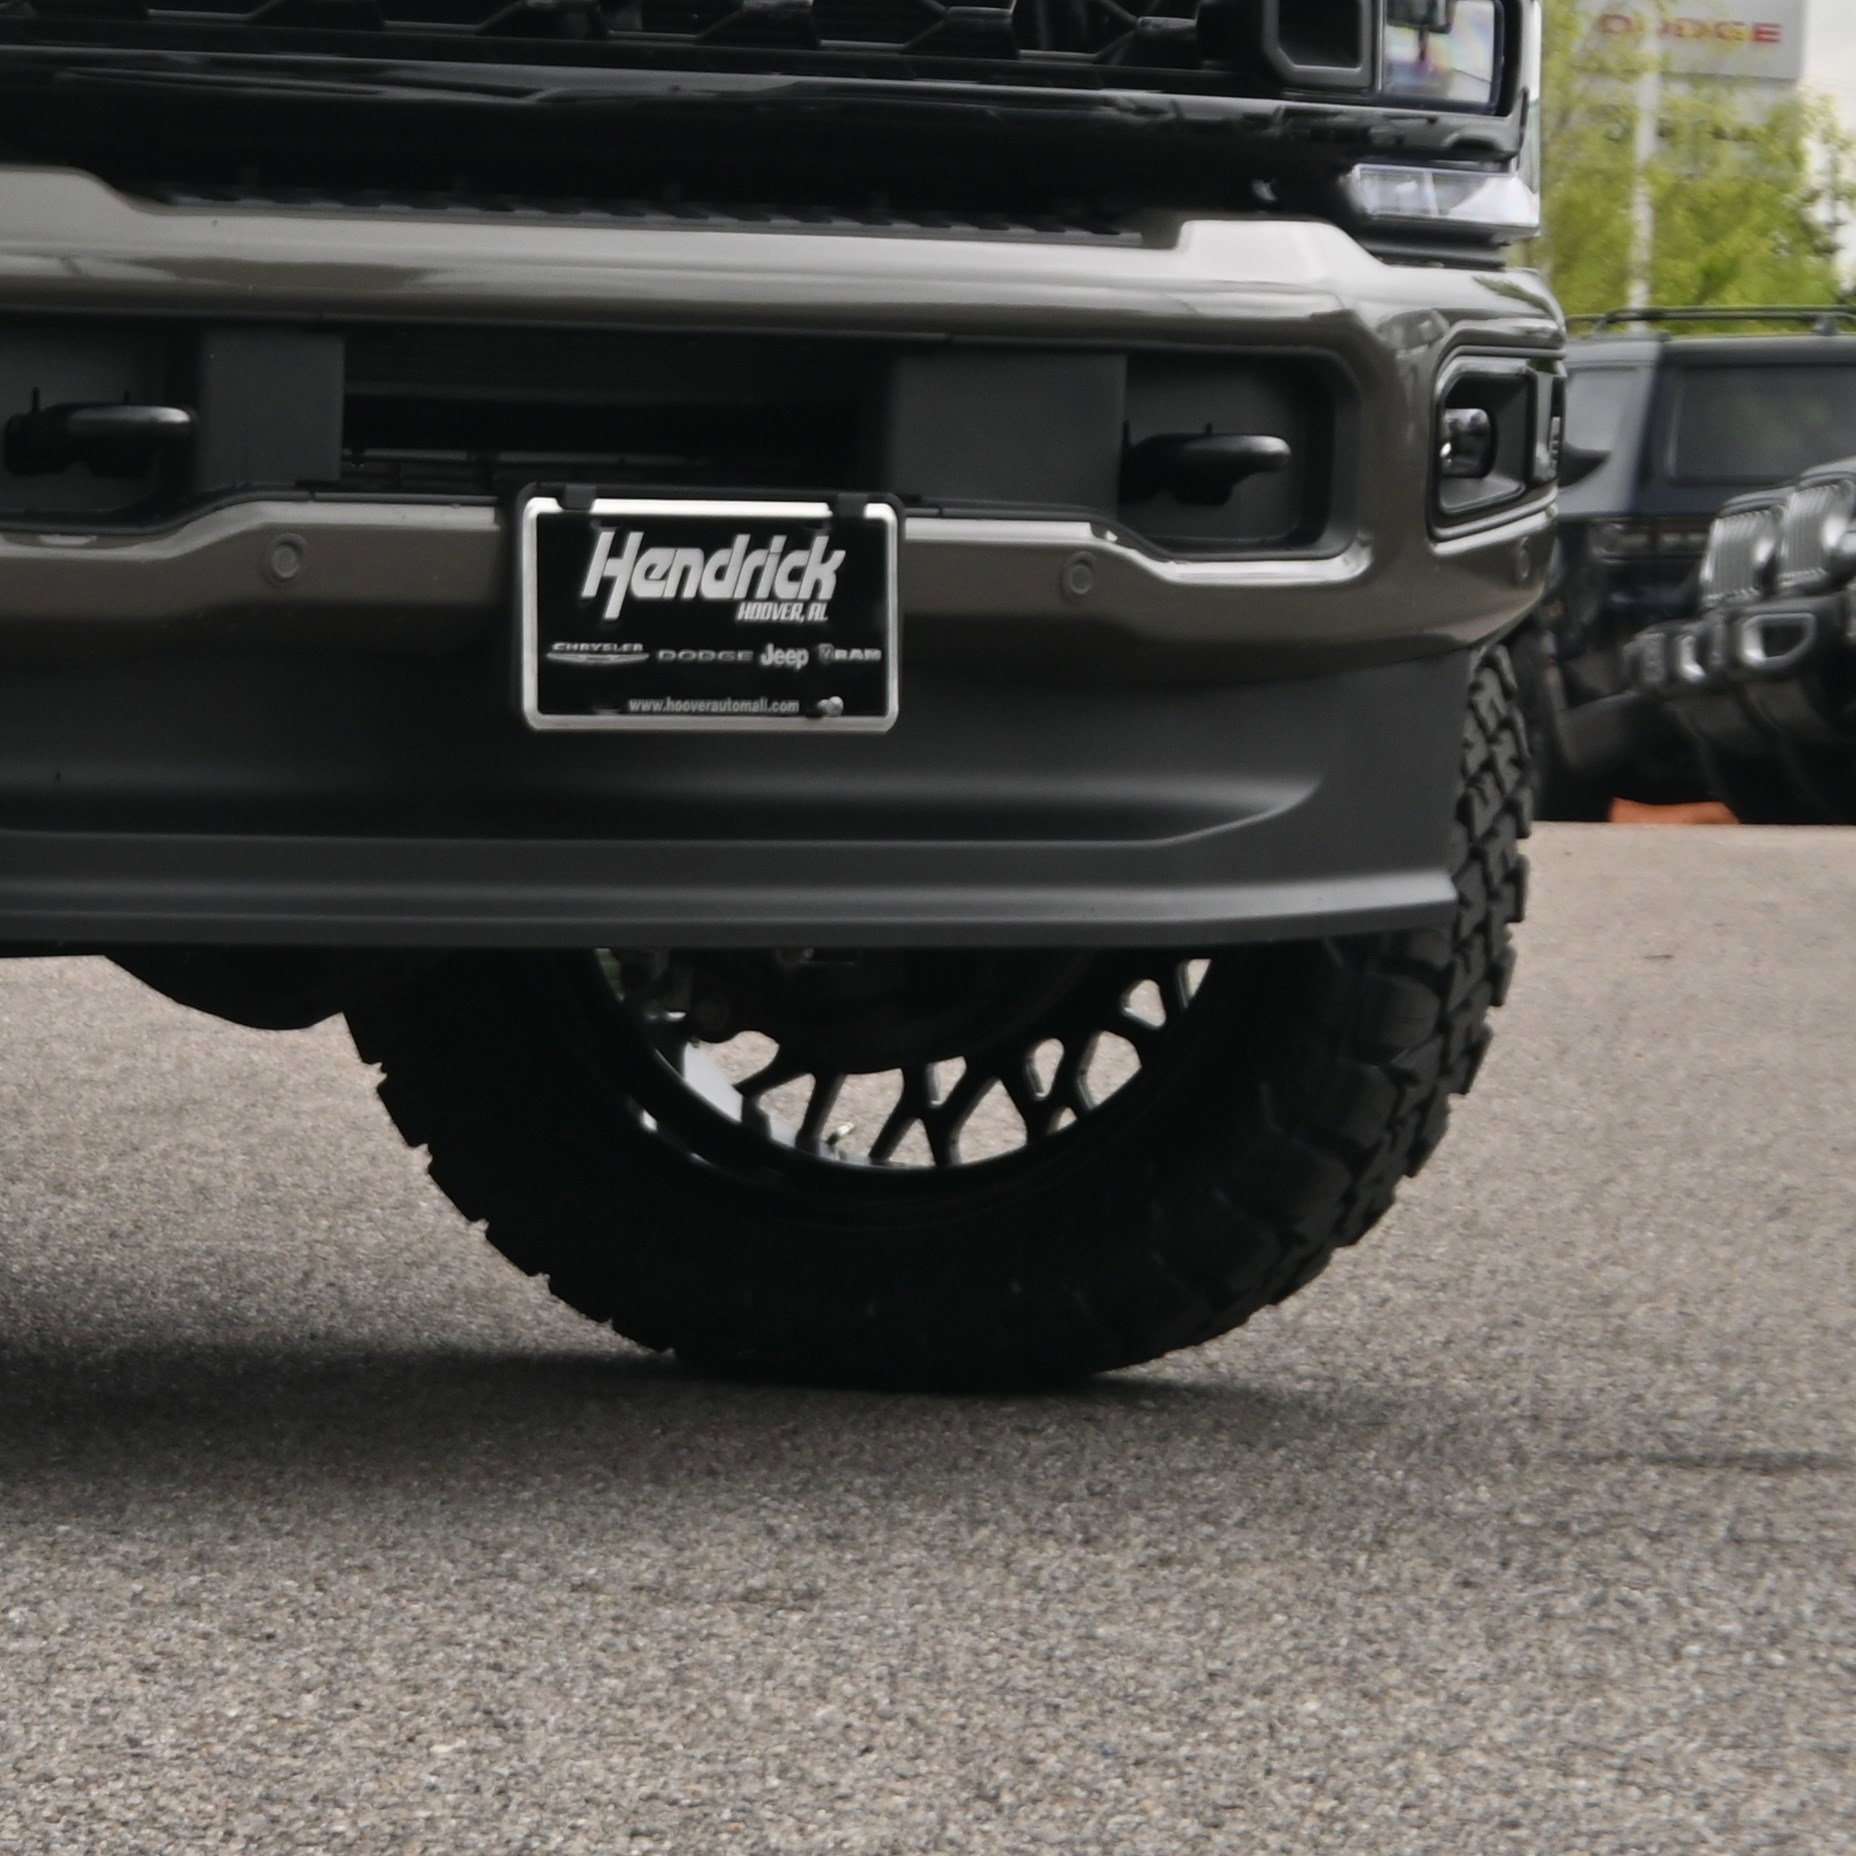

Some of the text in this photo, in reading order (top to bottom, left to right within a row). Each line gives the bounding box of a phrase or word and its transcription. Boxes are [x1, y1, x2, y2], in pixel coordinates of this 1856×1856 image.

[581, 531, 846, 621] Hendrick
[735, 601, 829, 623] HOOVER, AL
[551, 642, 882, 670] CHRYSLER DODGE Jeep RAM
[628, 696, 801, 715] www.hooverautomall.com
